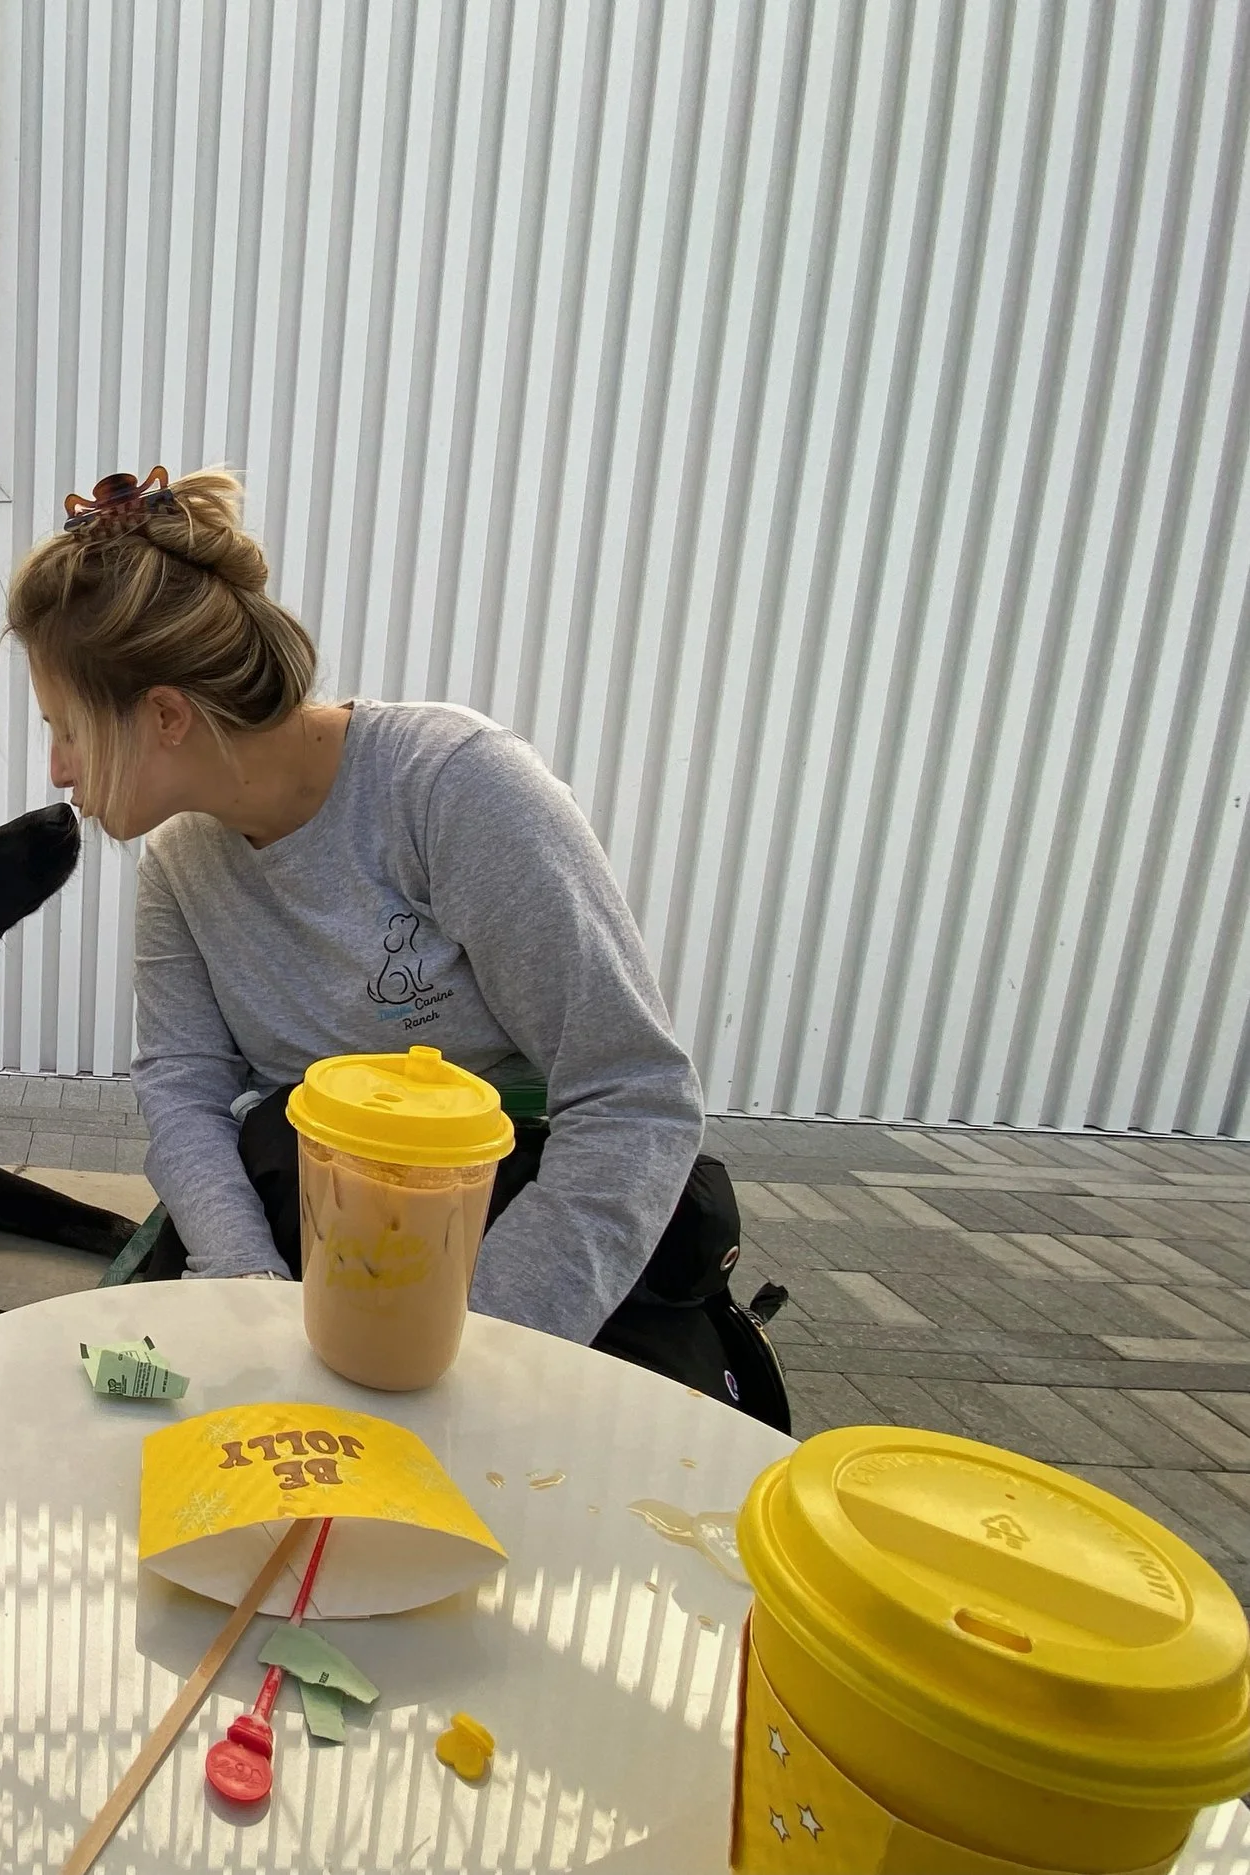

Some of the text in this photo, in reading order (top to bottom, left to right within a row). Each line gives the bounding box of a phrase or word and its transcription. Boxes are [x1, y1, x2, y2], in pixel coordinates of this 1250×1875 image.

[414, 989, 455, 1011] Canine
[402, 1010, 441, 1031] Ranch
[218, 1430, 366, 1469] JOLLY
[272, 1457, 344, 1491] BE
